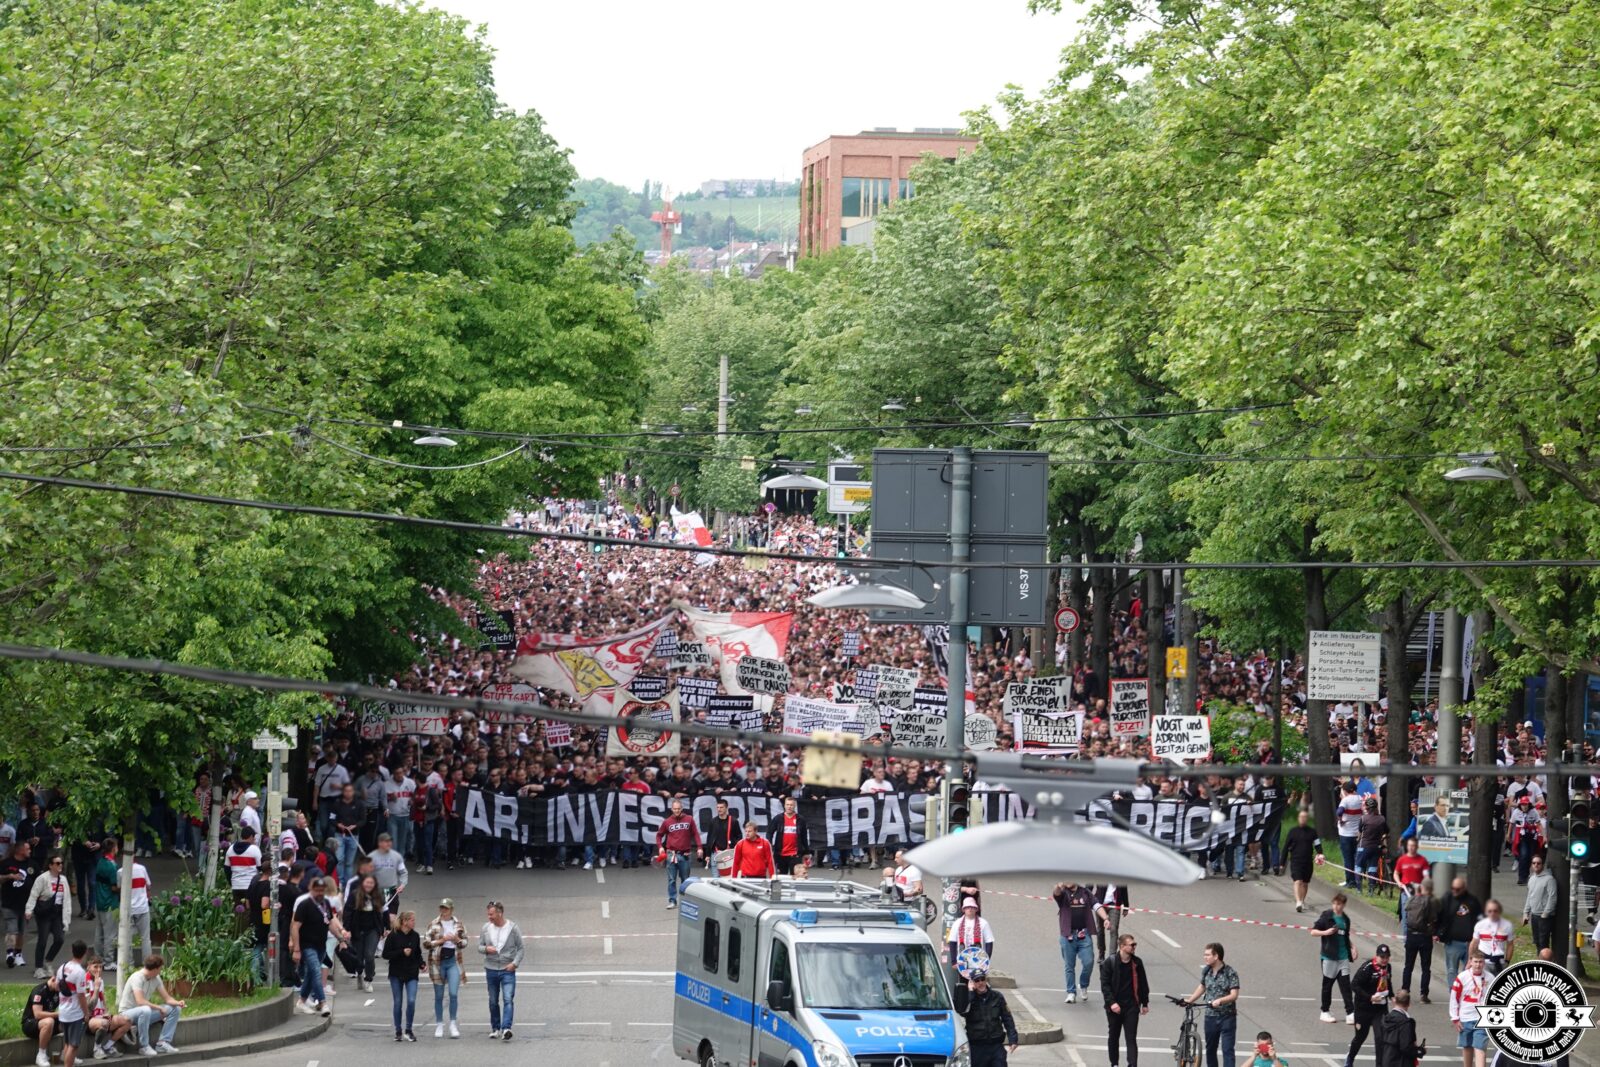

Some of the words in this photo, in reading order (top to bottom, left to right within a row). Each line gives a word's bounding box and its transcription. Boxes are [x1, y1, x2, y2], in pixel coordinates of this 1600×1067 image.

[1020, 568, 1029, 600] VIS-37
[677, 643, 703, 654] VOGT
[1320, 641, 1355, 649] Anlieferung
[742, 657, 757, 666] FÜR
[760, 660, 784, 671] EINEN
[740, 665, 775, 678] STARKEN
[857, 670, 877, 679] VOGT
[739, 676, 761, 688] VOGT
[764, 679, 789, 694] RAUS!
[856, 677, 877, 686] UND
[1112, 682, 1147, 692] VERRATEN
[836, 685, 855, 698] VO
[855, 688, 876, 698] RAUS
[1010, 684, 1027, 695] FÜR
[1031, 685, 1056, 696] EINEN
[679, 693, 709, 707] MAU
[914, 692, 948, 702] RÜCKTRI
[1011, 695, 1046, 706] STARKEN
[1120, 692, 1138, 701] UND
[365, 702, 387, 714] VOG
[914, 703, 948, 716] JETZ
[1112, 699, 1148, 712] VERKAUFT
[363, 715, 384, 725] ADR
[388, 717, 449, 733] JETZT!
[901, 714, 924, 724] VOGT
[925, 717, 943, 726] UND
[1156, 717, 1184, 731] VOGT
[1186, 719, 1203, 730] und
[896, 722, 926, 733] ADRION
[1023, 725, 1076, 736] BEDEUTET
[1113, 721, 1145, 732] JETZT!
[547, 735, 570, 745] WIR
[896, 733, 921, 742] ZEIT
[924, 735, 937, 743] ZU
[1155, 732, 1190, 744] ADRION
[1154, 745, 1174, 754] ZEIT
[464, 789, 528, 845] AR,
[1130, 801, 1273, 850] REICHT!
[687, 980, 711, 1004] POLIZEI
[855, 1026, 936, 1038] POLIZEI
